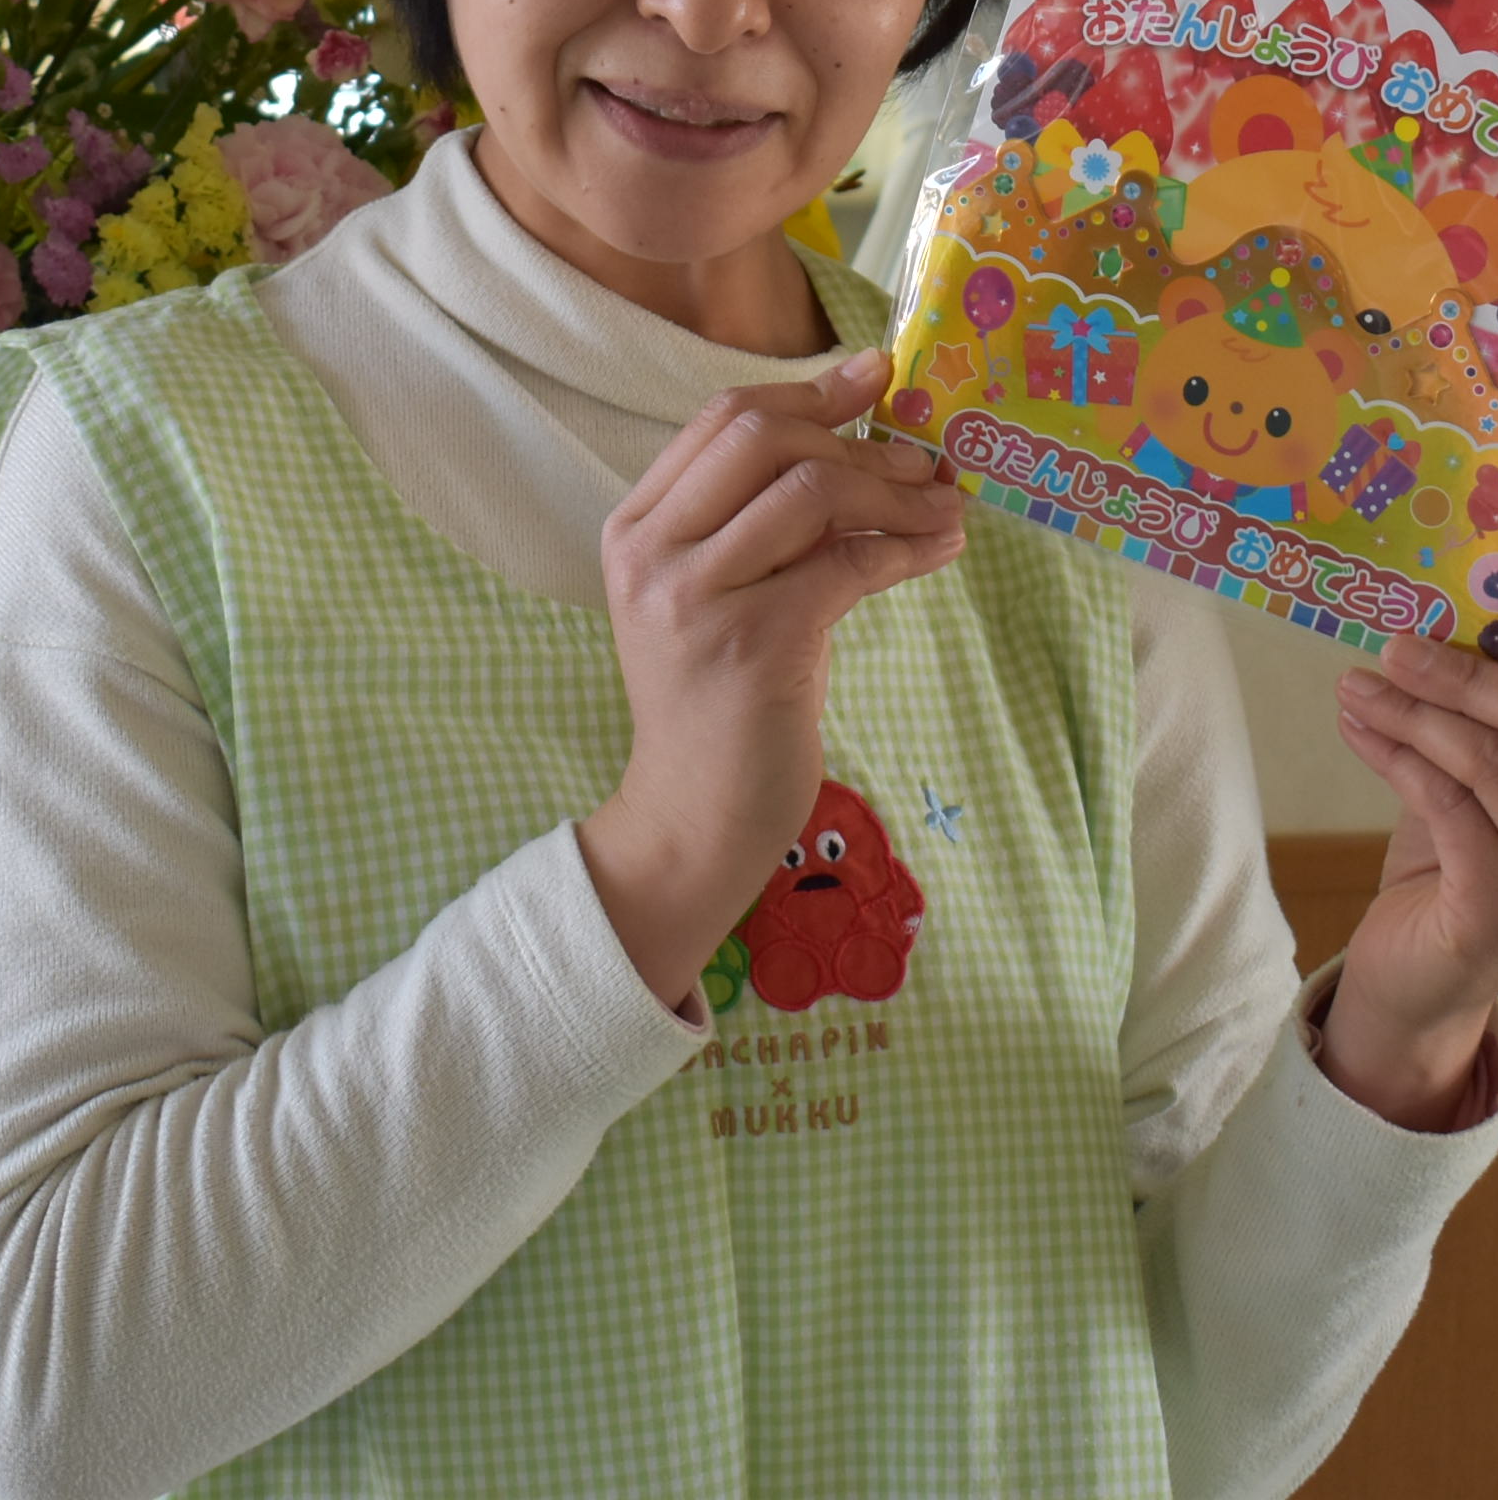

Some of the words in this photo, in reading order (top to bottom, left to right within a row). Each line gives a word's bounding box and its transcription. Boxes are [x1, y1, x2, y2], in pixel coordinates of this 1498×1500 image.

[956, 420, 1220, 547] おたんじょうび
[1227, 527, 1446, 636] おめでとう!
[678, 1021, 890, 1073] ACHAPIN
[710, 1093, 861, 1140] MUKKU
